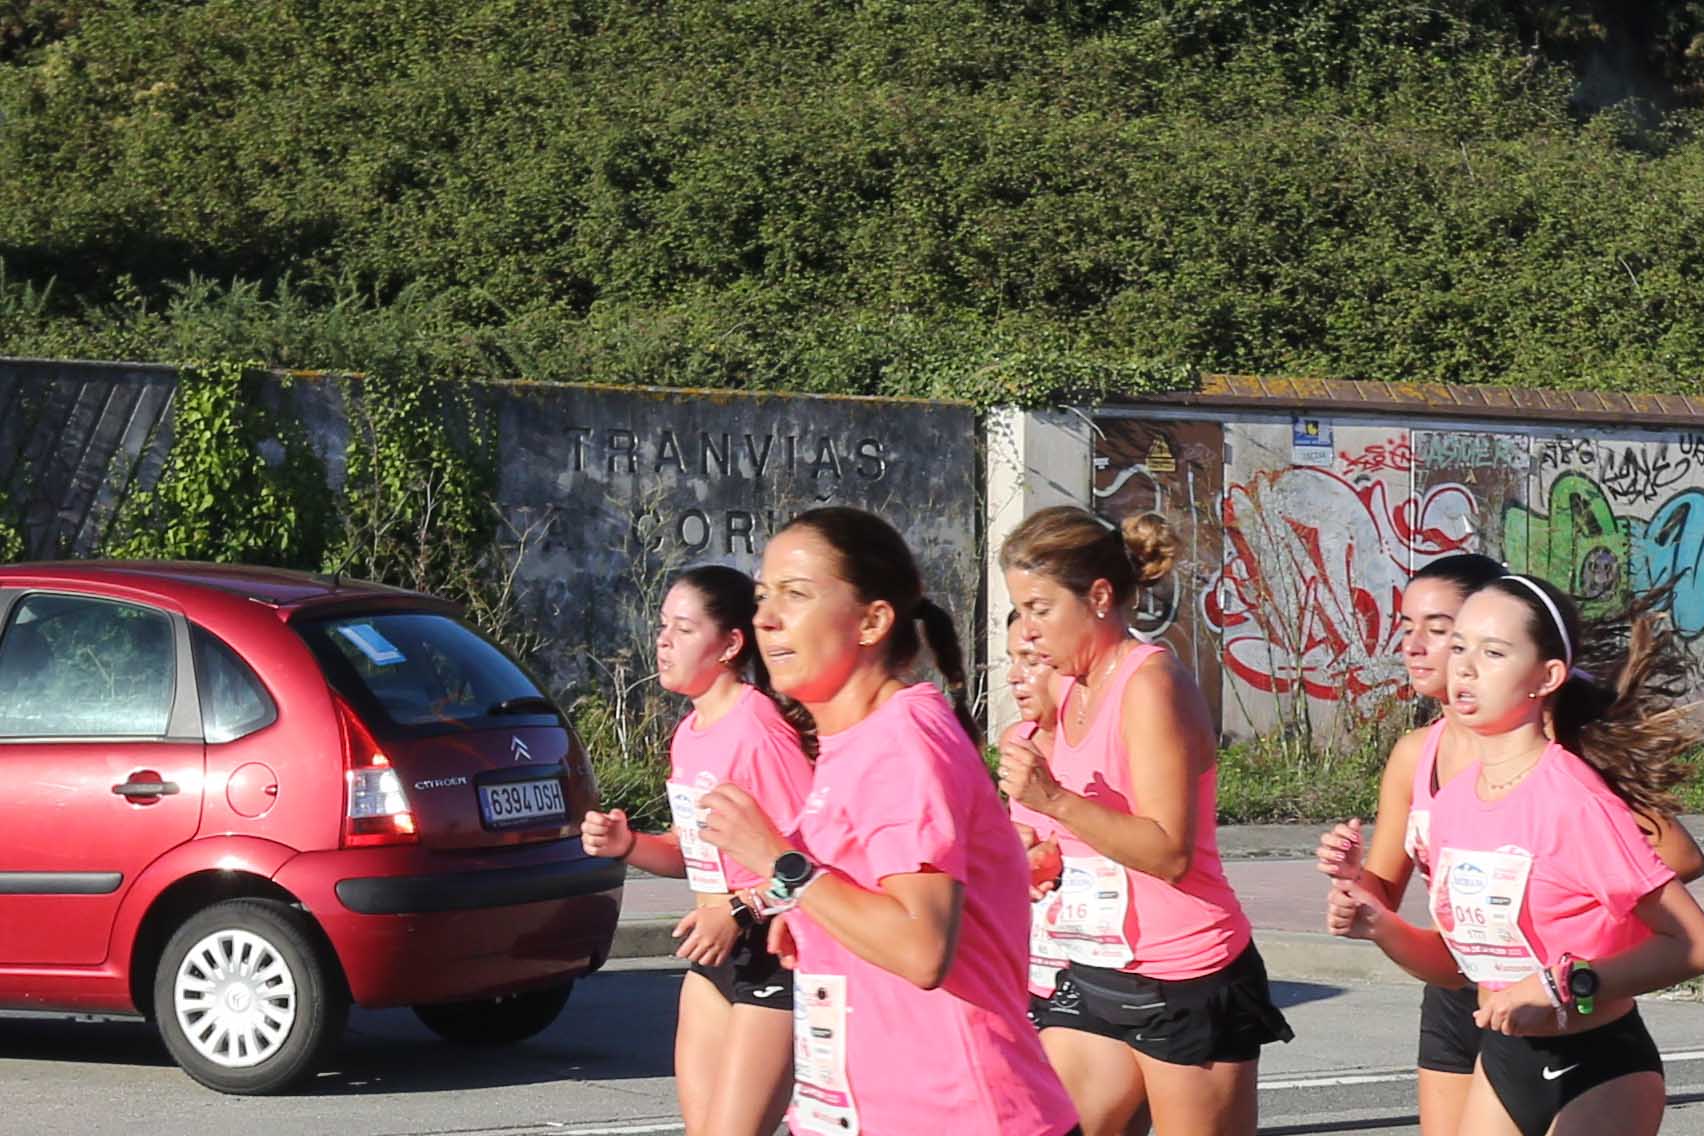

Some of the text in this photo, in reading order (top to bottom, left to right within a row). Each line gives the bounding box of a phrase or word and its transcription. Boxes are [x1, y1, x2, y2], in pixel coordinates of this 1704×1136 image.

[563, 427, 887, 481] TRANVIAS
[632, 494, 832, 554] COR
[490, 782, 563, 816] 6394 DSH
[1060, 904, 1088, 919] 16
[1455, 905, 1485, 924] 016
